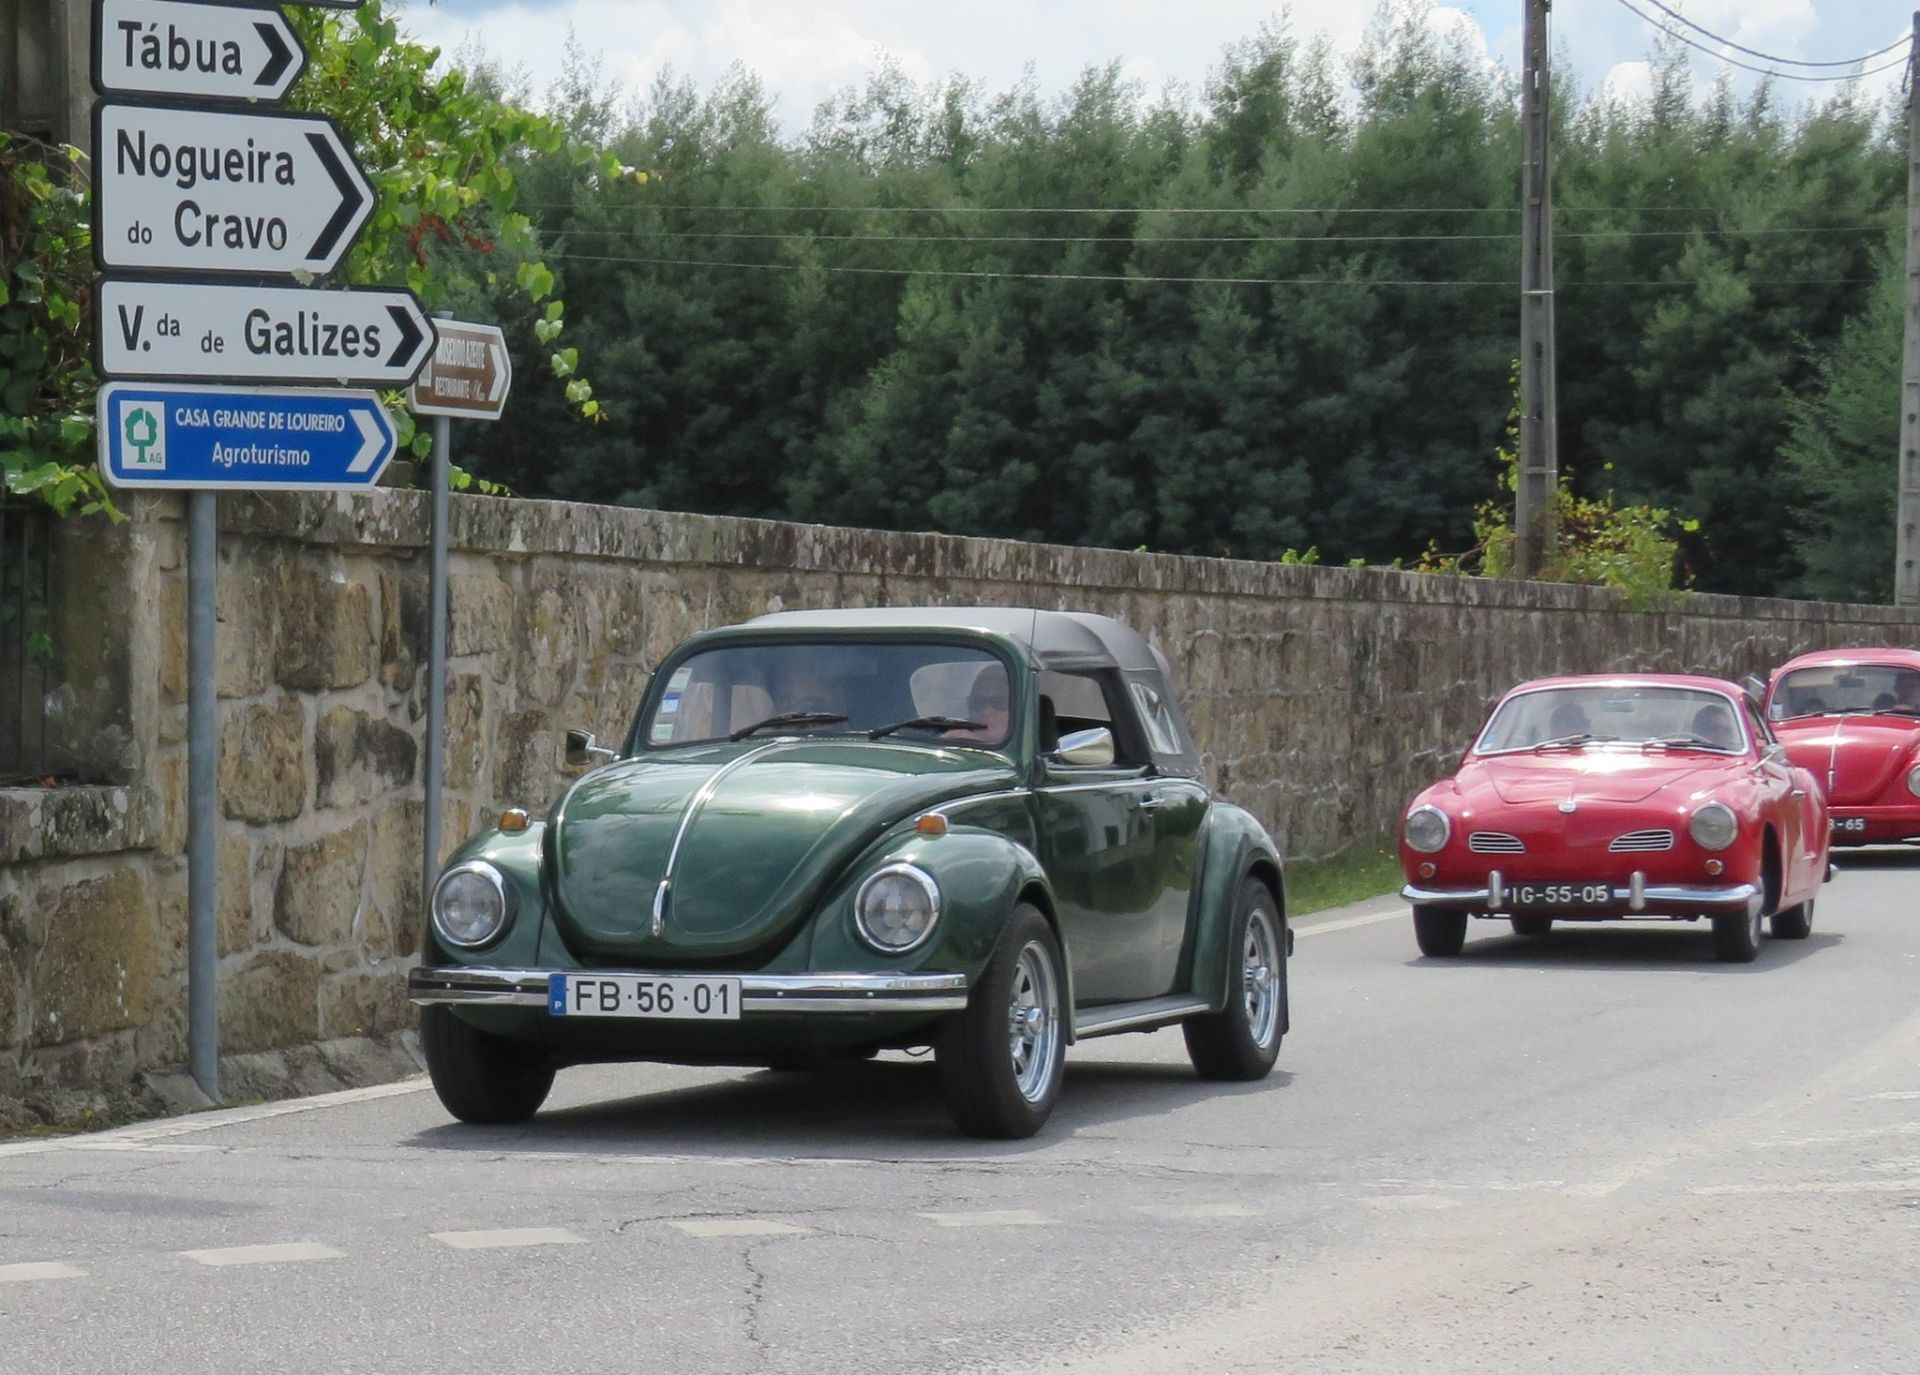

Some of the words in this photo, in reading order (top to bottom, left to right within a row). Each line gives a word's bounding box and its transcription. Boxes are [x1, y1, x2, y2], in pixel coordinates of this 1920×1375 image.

[117, 20, 242, 76] Tábua
[117, 128, 295, 190] Nogueira
[127, 220, 152, 244] do
[174, 199, 288, 251] Cravo
[201, 330, 224, 353] de
[244, 308, 381, 358] Galizes
[175, 408, 211, 427] CASA
[213, 410, 265, 429] GRANDE
[269, 413, 284, 430] DE
[287, 413, 345, 432] LOUREIRO
[149, 453, 162, 464] AG
[212, 441, 310, 467] Agroturismo
[1512, 885, 1609, 904] IG-55-05
[554, 1001, 562, 1010] P
